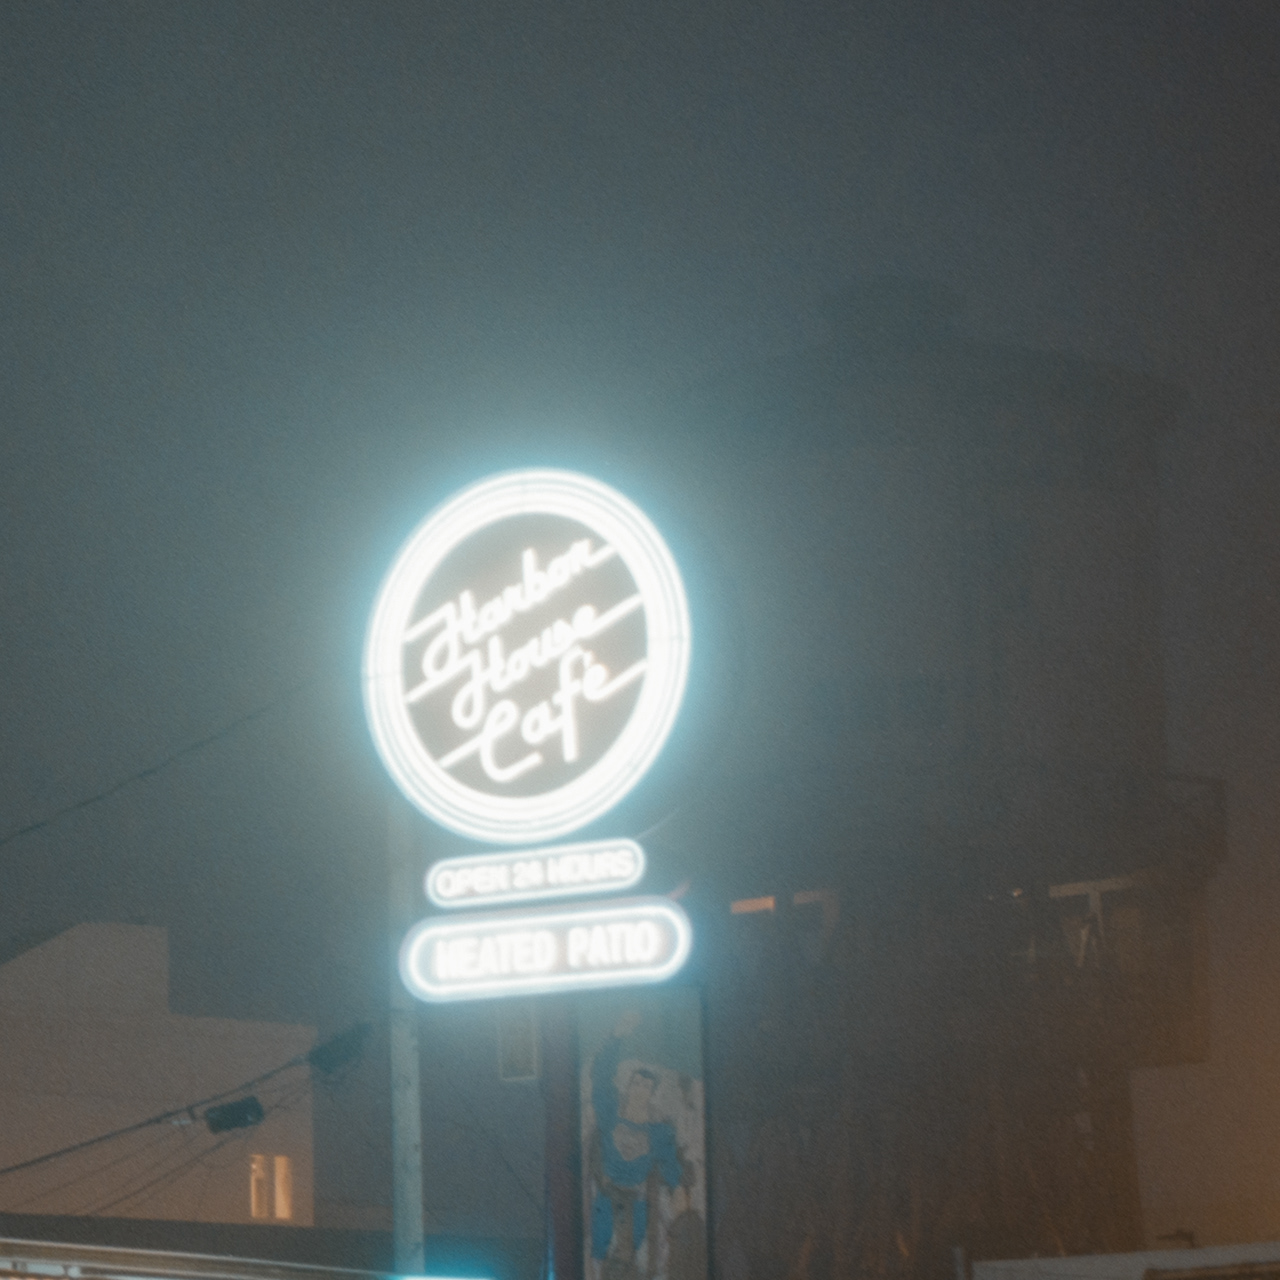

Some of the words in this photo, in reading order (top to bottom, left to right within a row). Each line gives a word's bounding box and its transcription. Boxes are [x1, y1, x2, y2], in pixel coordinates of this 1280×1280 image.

[410, 538, 606, 682] Harbor
[432, 599, 620, 730] House
[437, 864, 511, 897] OPEN
[513, 859, 544, 889] 24
[546, 850, 635, 884] HOURS
[434, 928, 558, 980] HEATED
[567, 920, 659, 969] PATIO
